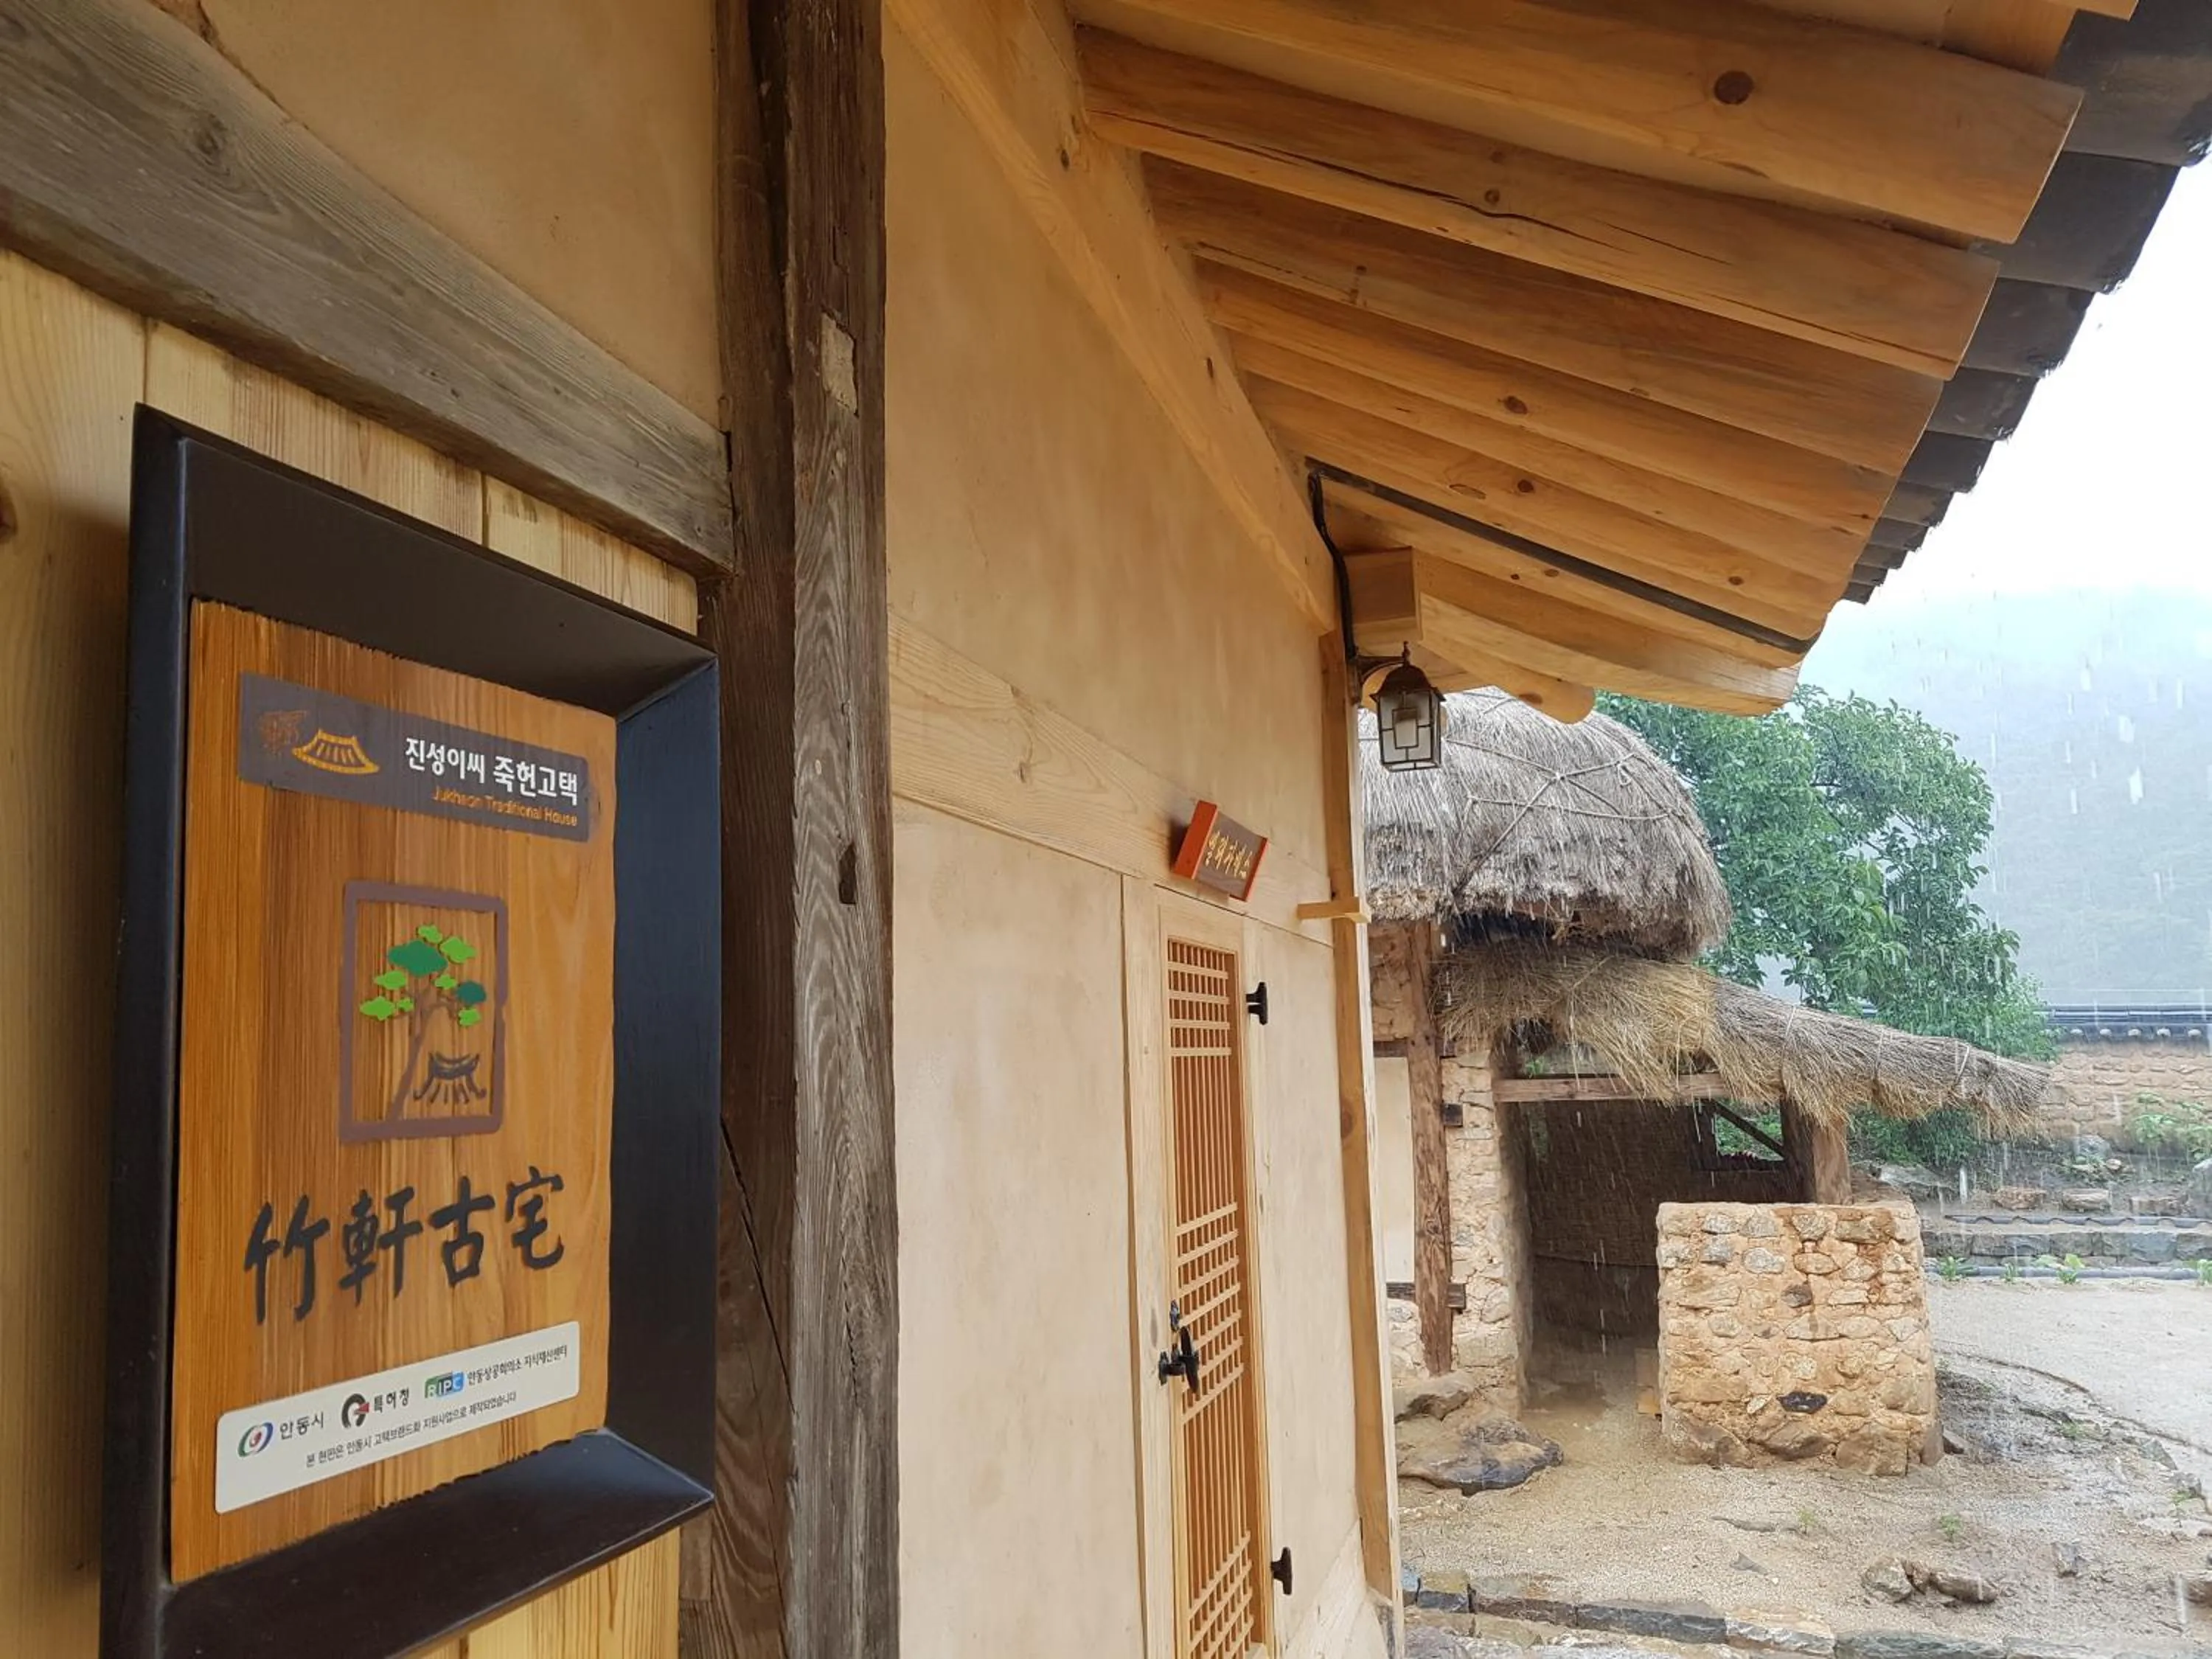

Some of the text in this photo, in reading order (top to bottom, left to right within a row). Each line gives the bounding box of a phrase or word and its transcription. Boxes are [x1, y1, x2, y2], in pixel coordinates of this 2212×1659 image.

[406, 737, 578, 806] 진성이씨 죽헌고택
[485, 795, 543, 820] Traditional
[544, 806, 578, 827] House
[244, 1165, 565, 1326] 竹軒古宅
[374, 1388, 410, 1413] 특허청
[426, 1374, 464, 1399] RIPC
[279, 1411, 324, 1440] 안동시
